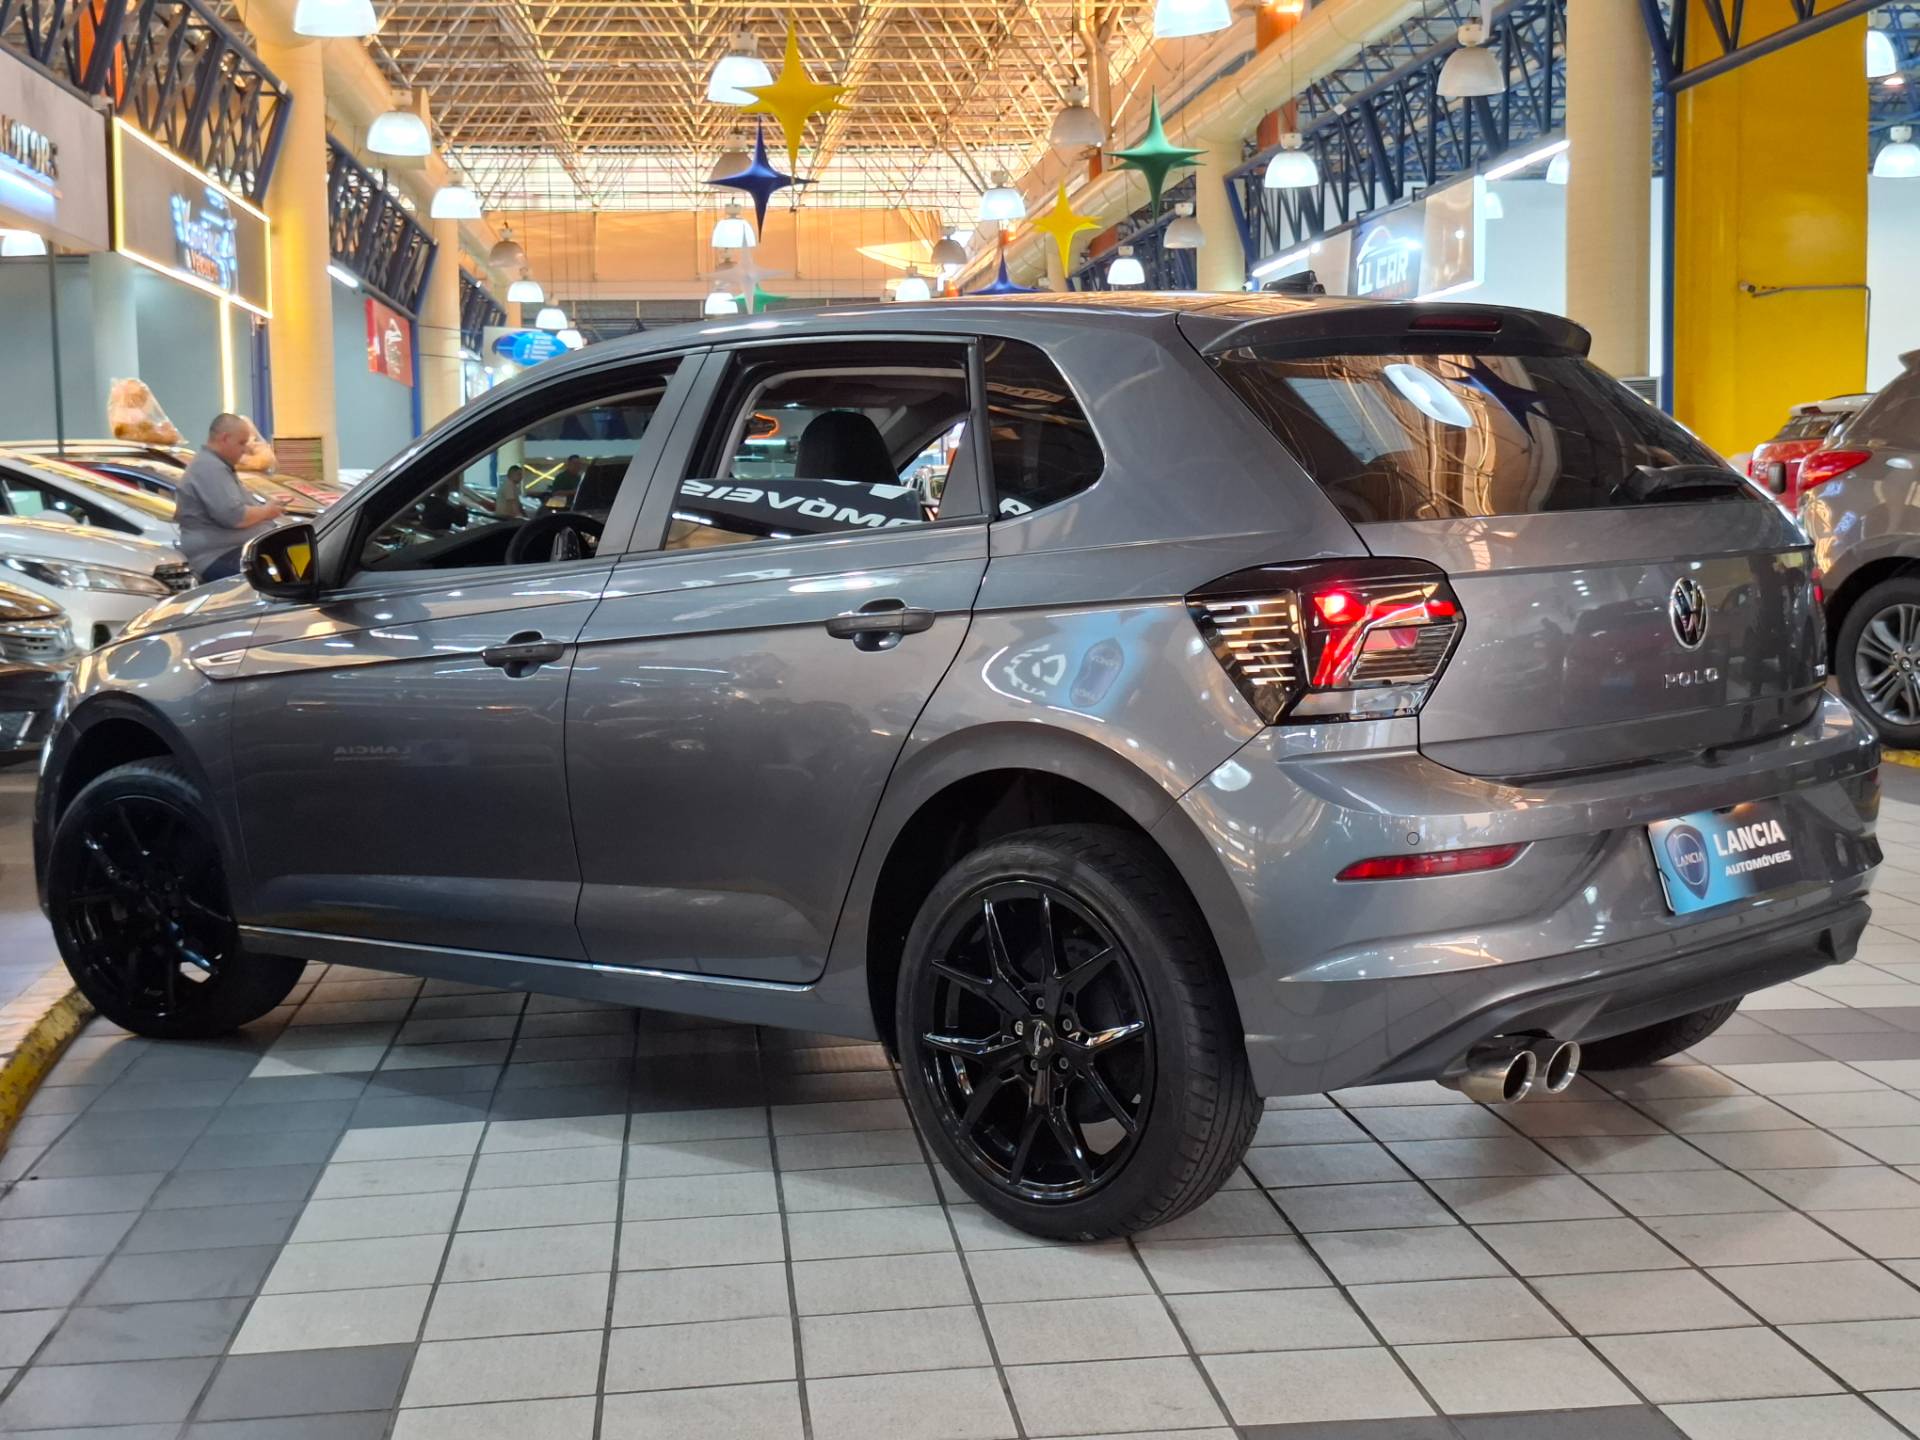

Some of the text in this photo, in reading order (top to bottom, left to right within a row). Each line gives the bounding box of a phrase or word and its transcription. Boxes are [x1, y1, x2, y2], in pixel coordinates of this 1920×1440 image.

[1375, 248, 1408, 289] CAR
[1664, 667, 1719, 689] POLO
[1713, 819, 1787, 857] LANCIA
[1674, 851, 1704, 868] LANCIA
[1725, 850, 1793, 877] AUTOMÓVEIS
